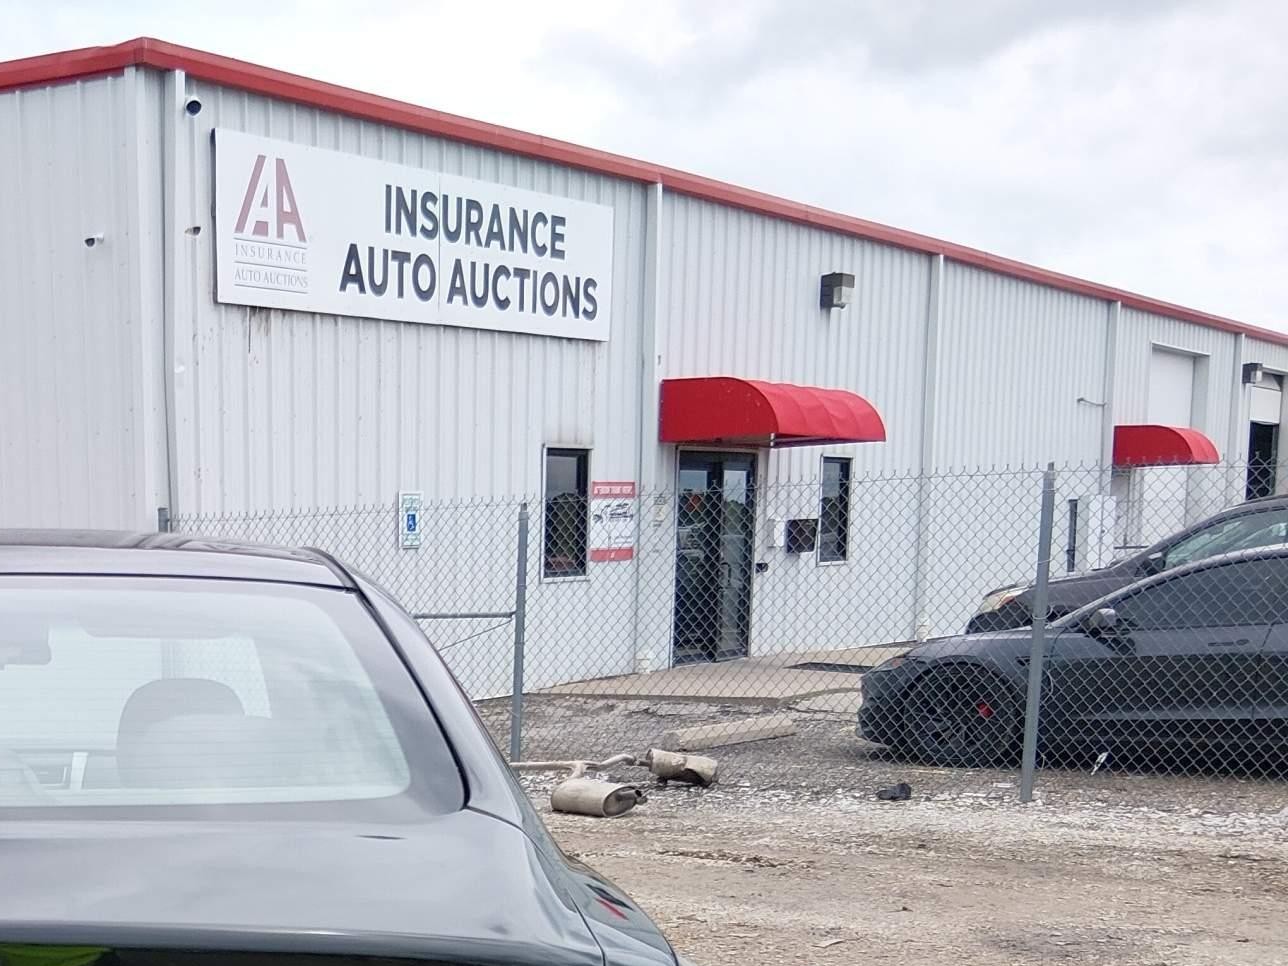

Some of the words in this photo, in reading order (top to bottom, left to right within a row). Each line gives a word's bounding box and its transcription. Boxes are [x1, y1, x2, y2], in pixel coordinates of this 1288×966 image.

[384, 184, 566, 259] INSURANCE
[234, 243, 307, 265] INSURANCE
[234, 268, 261, 282] AUTO
[263, 271, 308, 288] AUCTIONS
[339, 243, 437, 302] AUTO
[446, 258, 598, 321] AUCTIONS
